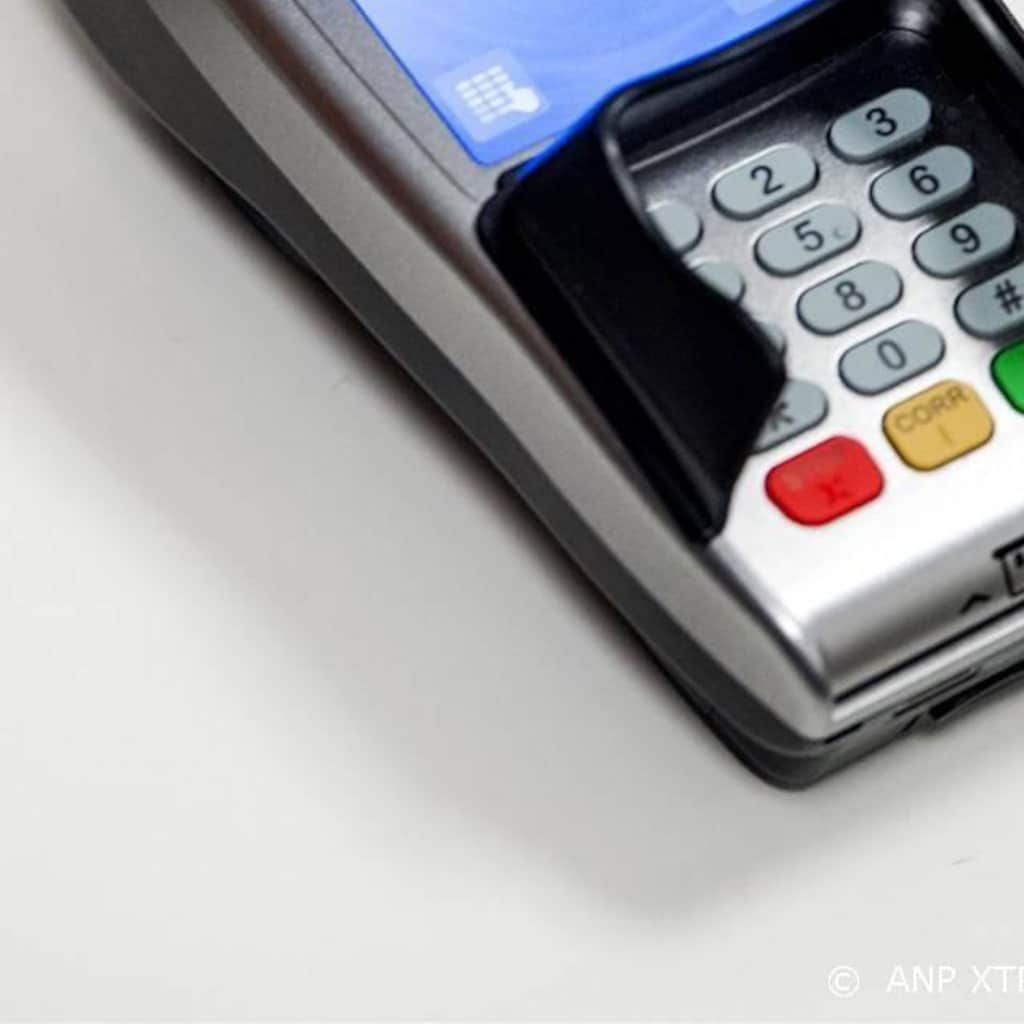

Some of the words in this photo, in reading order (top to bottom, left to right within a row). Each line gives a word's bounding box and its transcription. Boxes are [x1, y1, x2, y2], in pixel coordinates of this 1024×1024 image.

[865, 106, 898, 137] 3
[749, 164, 784, 196] 2
[908, 165, 941, 195] 6
[793, 219, 825, 252] 5
[949, 223, 982, 255] 9
[835, 281, 867, 312] 8
[877, 339, 907, 371] 0
[895, 384, 968, 434] CORR
